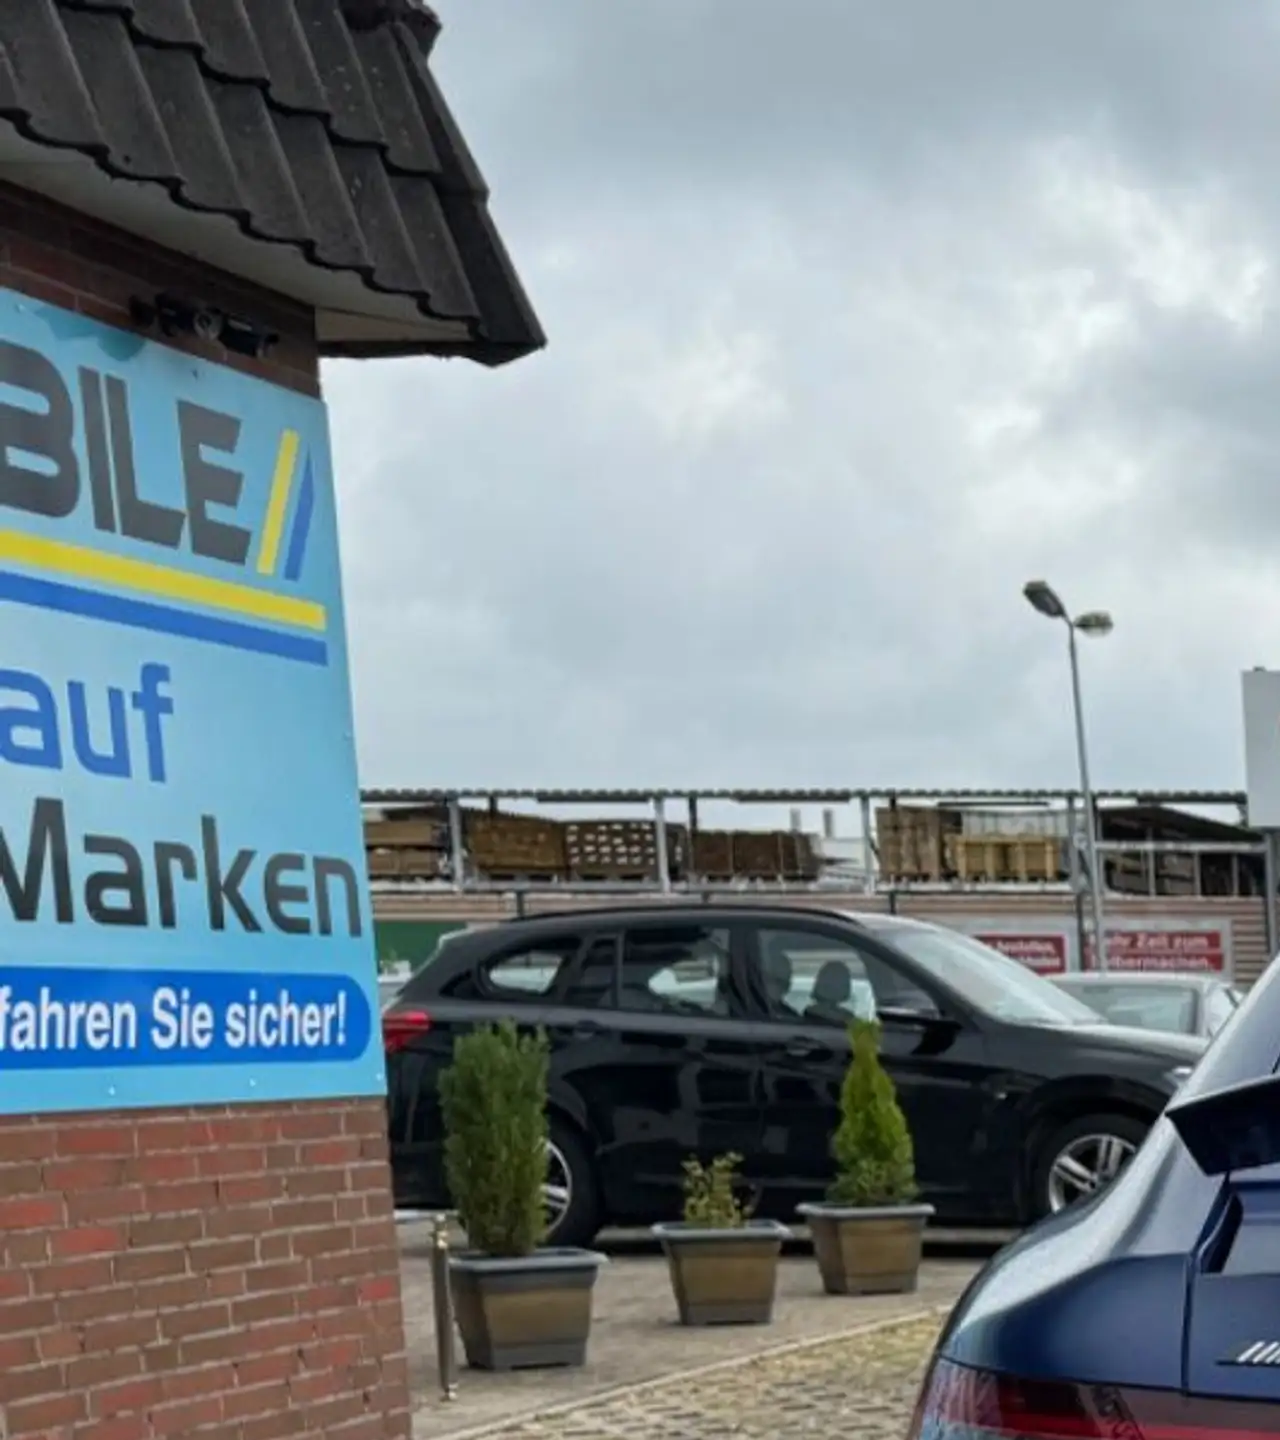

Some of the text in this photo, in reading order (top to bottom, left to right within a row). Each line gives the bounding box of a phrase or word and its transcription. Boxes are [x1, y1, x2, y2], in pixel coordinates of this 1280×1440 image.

[0, 337, 252, 567] BILE
[0, 662, 174, 783] auf
[150, 991, 214, 1052] Sie
[224, 993, 348, 1049] sicher!
